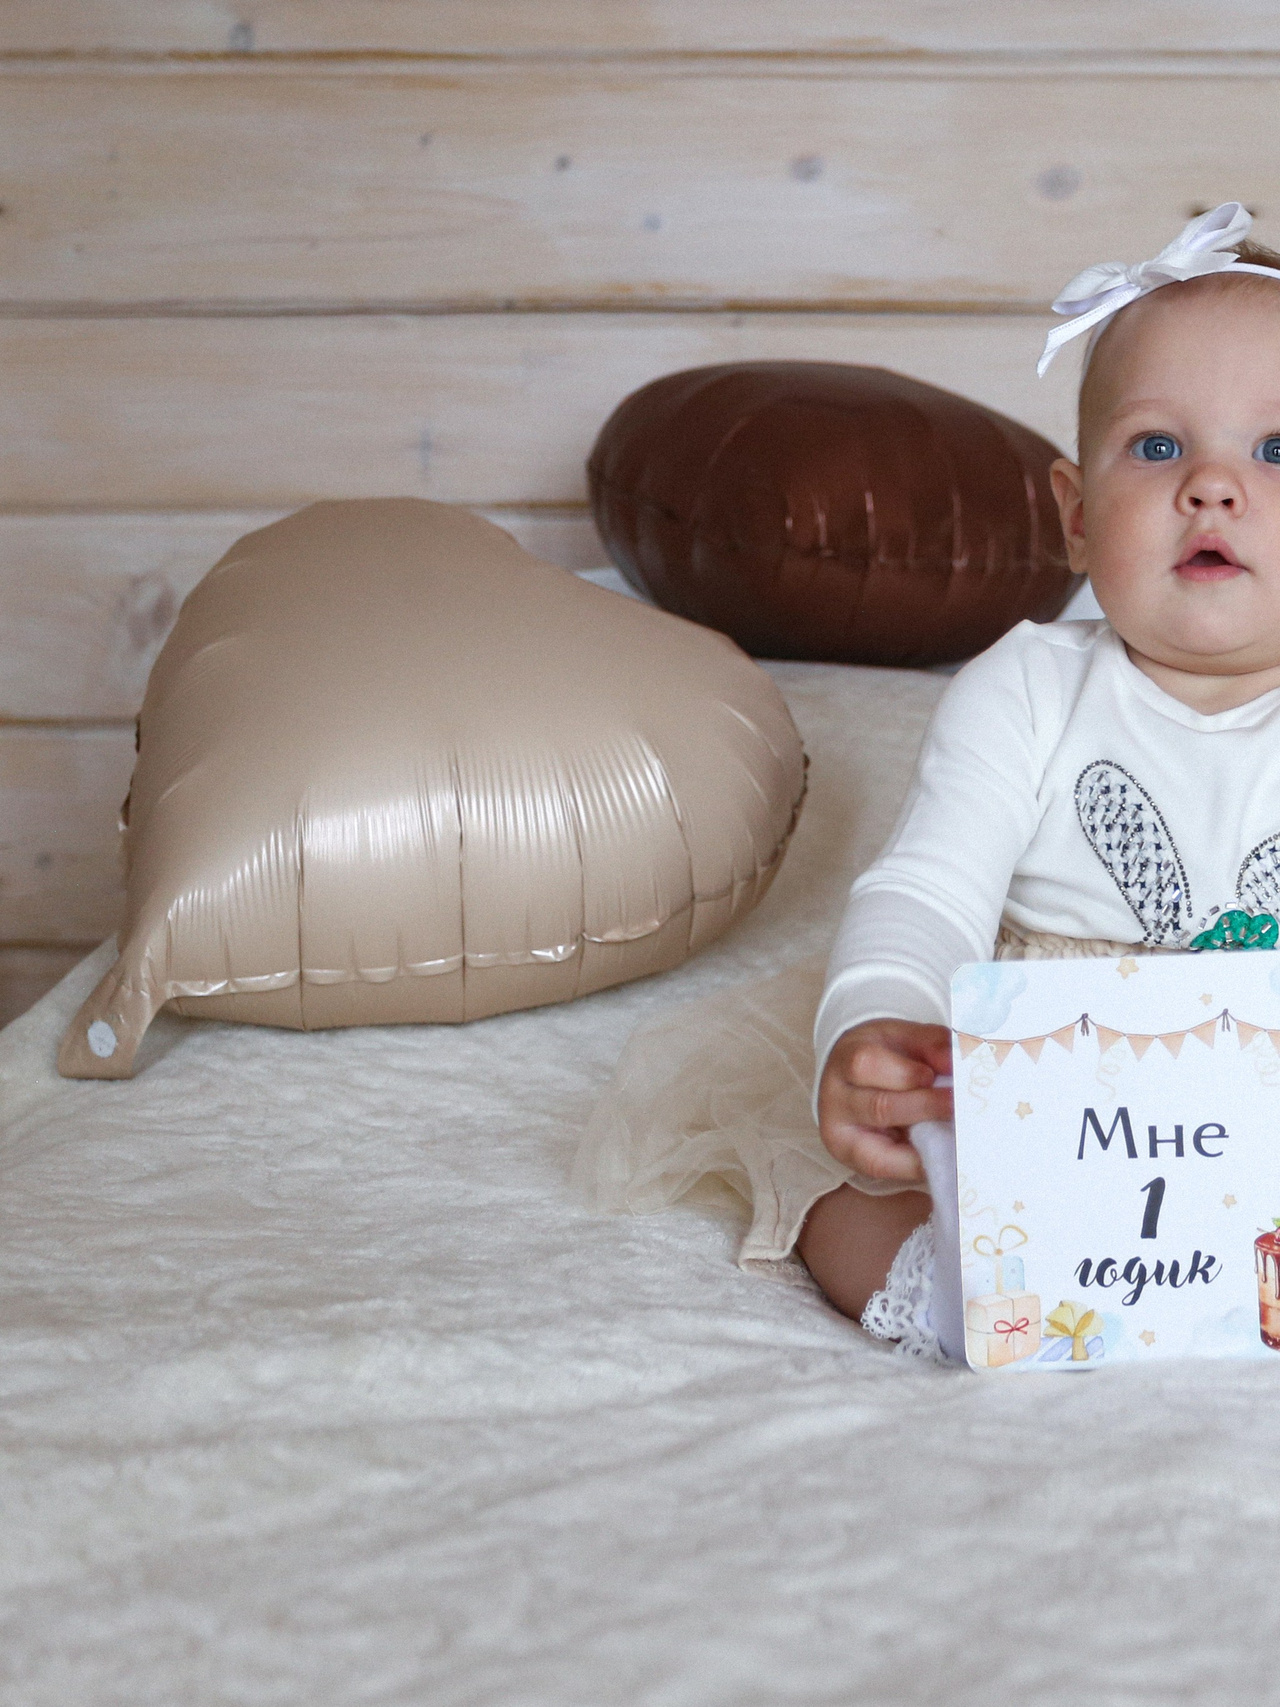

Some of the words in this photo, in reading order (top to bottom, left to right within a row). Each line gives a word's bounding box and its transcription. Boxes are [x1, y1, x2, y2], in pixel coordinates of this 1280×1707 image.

[1077, 1107, 1229, 1160] Мне
[1140, 1176, 1166, 1239] 1
[1073, 1250, 1223, 1306] годик
